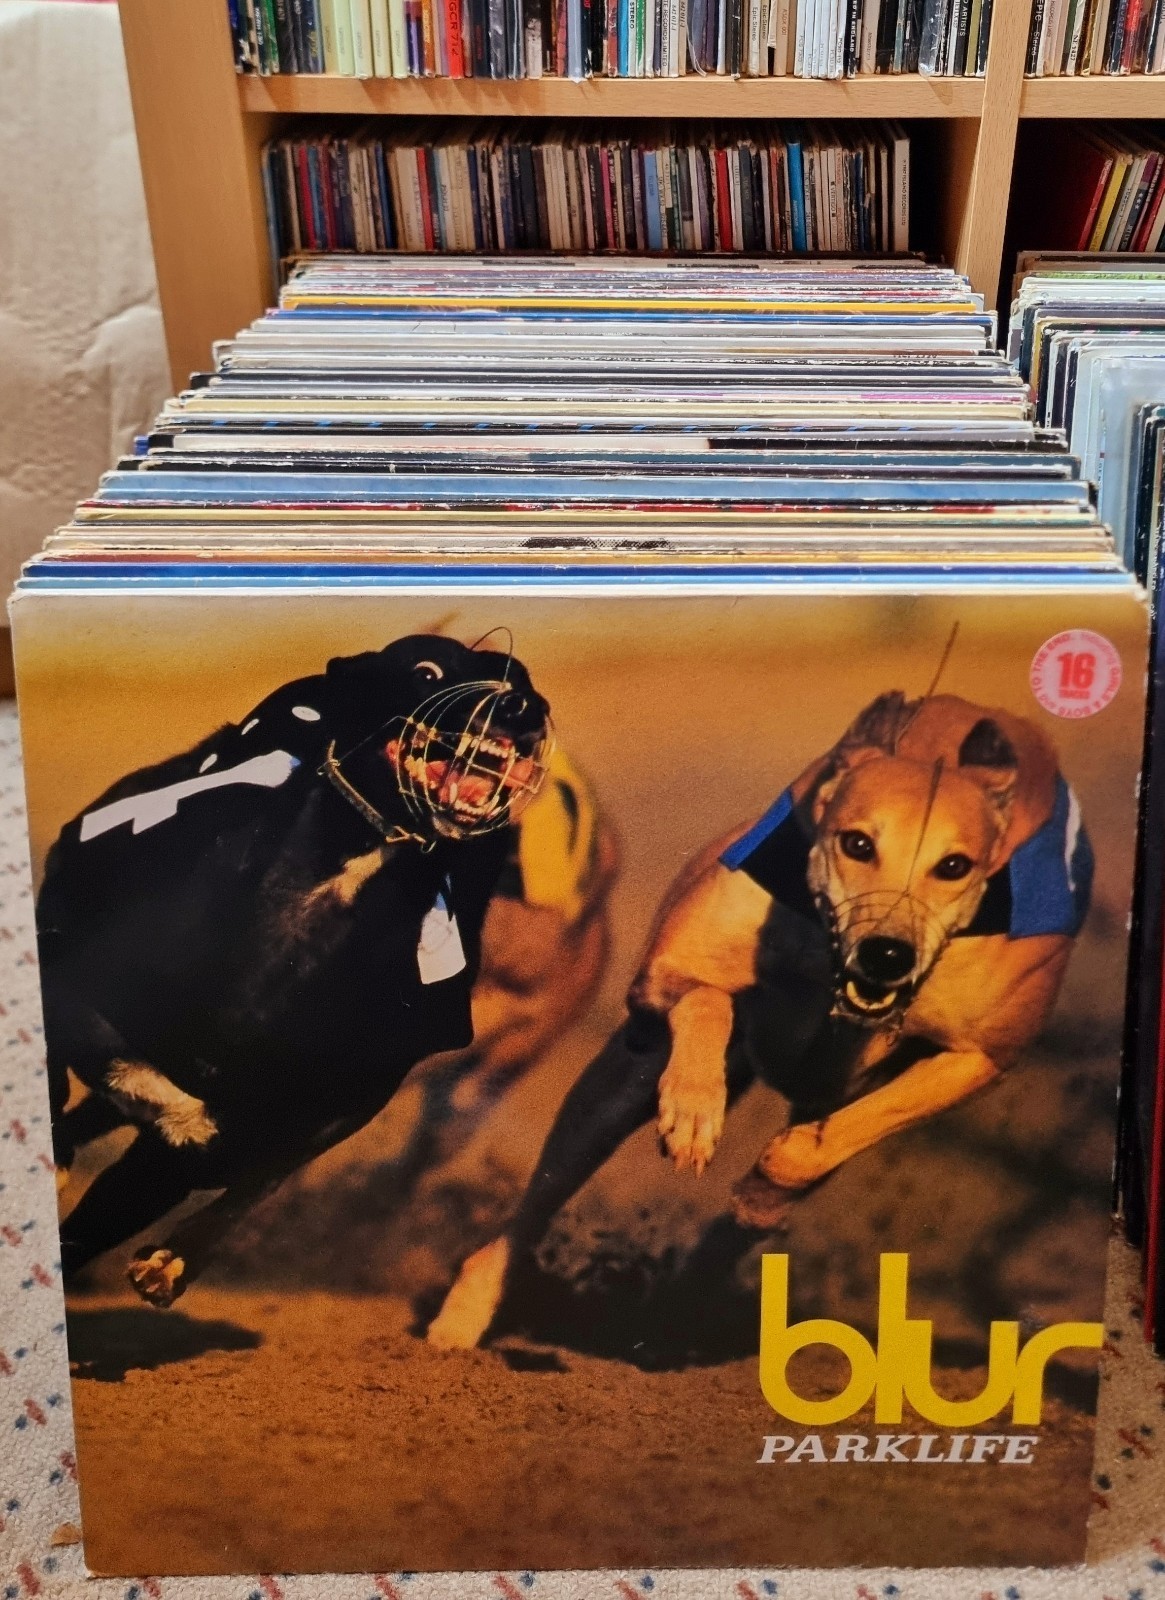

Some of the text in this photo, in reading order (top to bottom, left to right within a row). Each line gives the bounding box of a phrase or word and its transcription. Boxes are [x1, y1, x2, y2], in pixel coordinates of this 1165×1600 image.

[449, 0, 458, 30] GCR
[959, 6, 968, 37] ARTISTS
[1031, 31, 1041, 56] Stereo
[1057, 652, 1097, 690] 16
[1058, 705, 1092, 718] BOYS
[759, 1252, 1104, 1427] blur
[756, 1434, 1039, 1464] PARKLIFE
